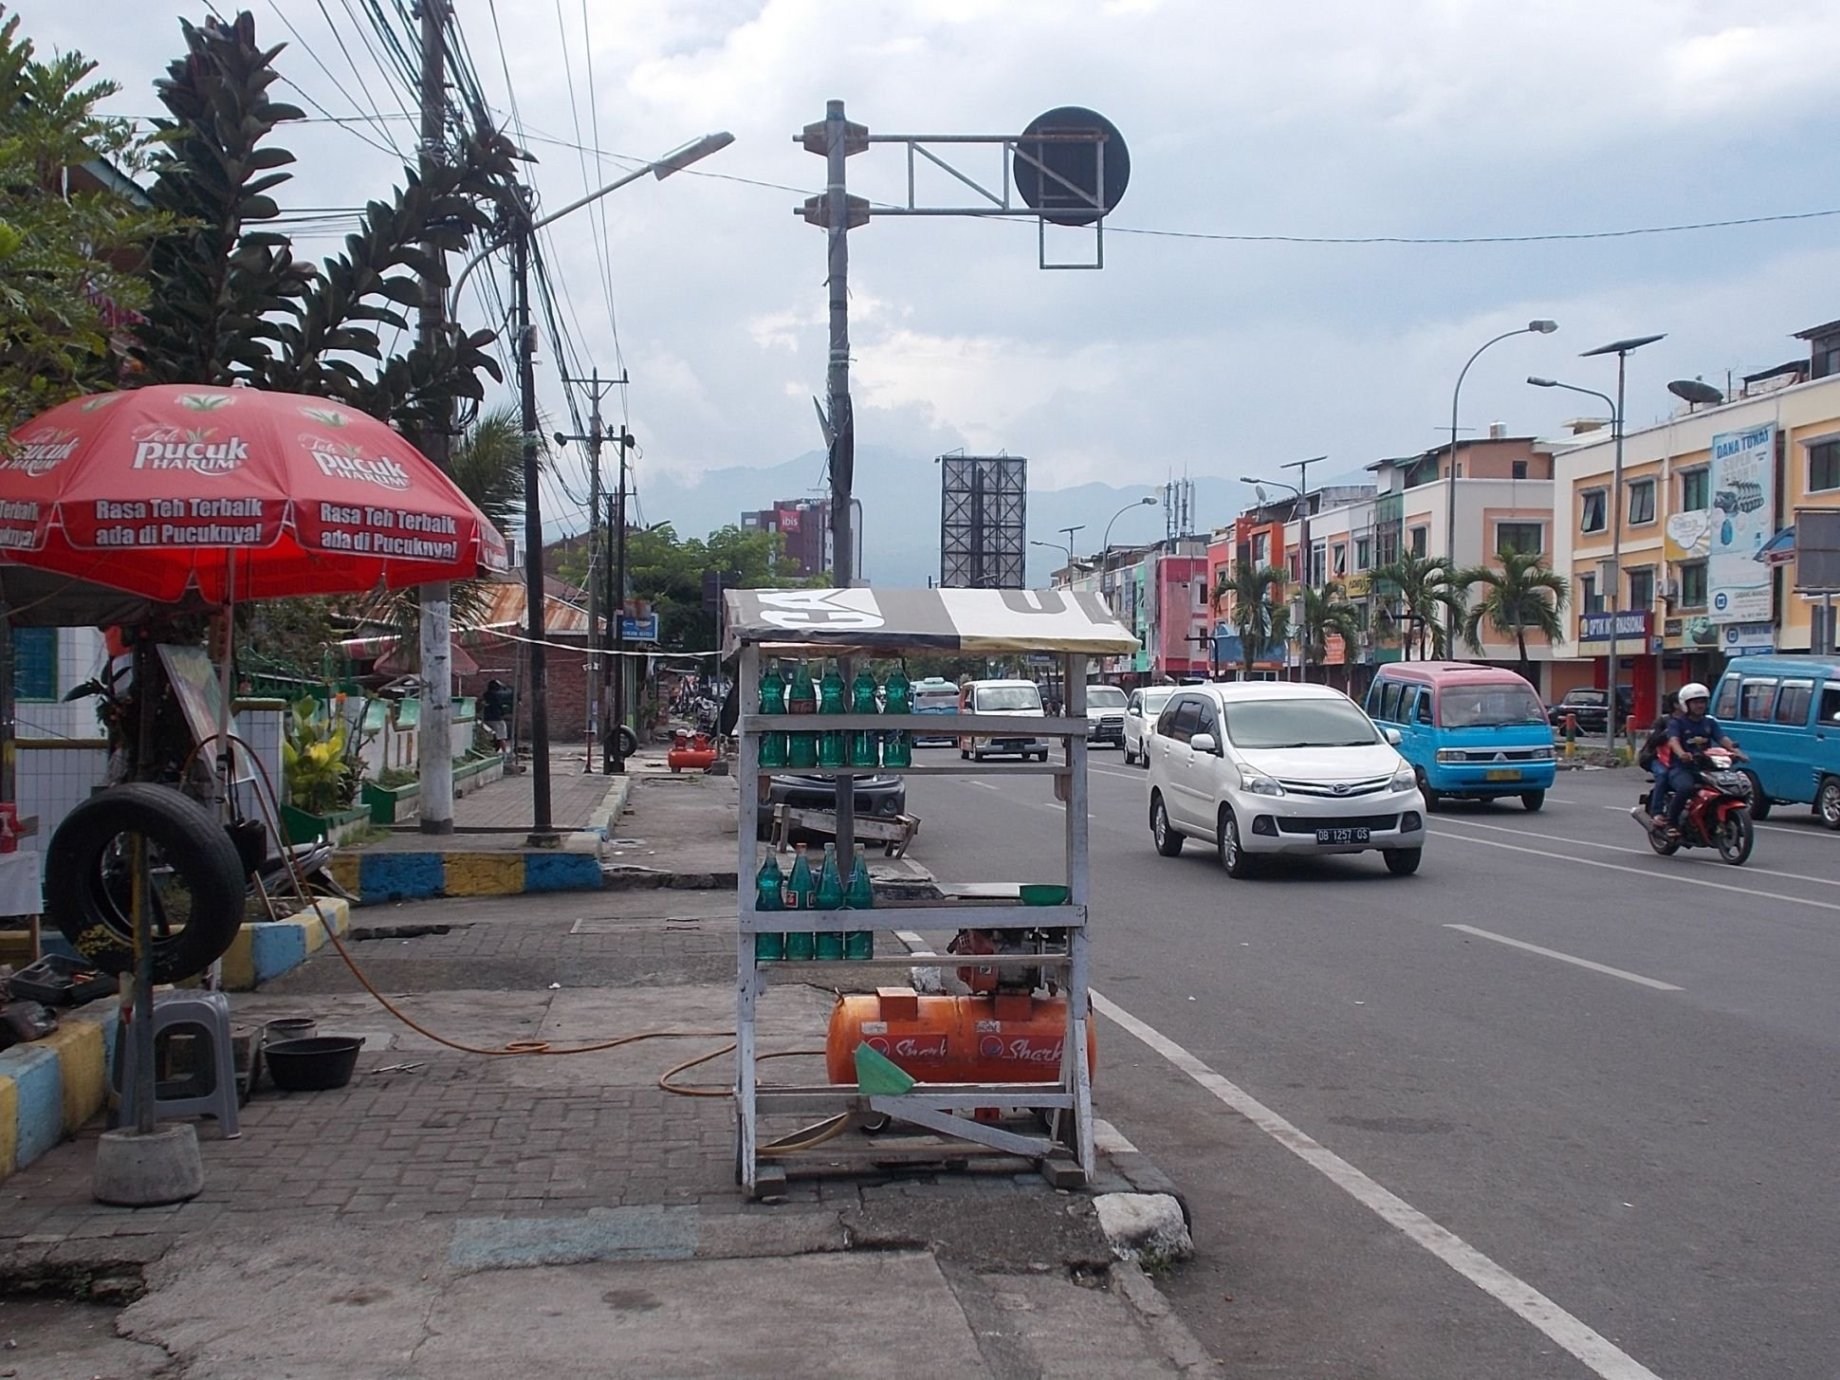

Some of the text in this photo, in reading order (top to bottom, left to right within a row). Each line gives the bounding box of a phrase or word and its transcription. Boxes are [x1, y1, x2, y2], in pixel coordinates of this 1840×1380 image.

[1717, 440, 1739, 459] DANA
[96, 498, 263, 519] Rasa Teh Terbaik
[320, 503, 457, 534] Rasa Teh Terbaik
[782, 516, 798, 526] ibis
[96, 523, 262, 545] ada di Pucuknya!
[321, 530, 457, 558] ada di Pucuknya!
[1589, 619, 1604, 635] OPTIK
[1334, 829, 1352, 841] 1257
